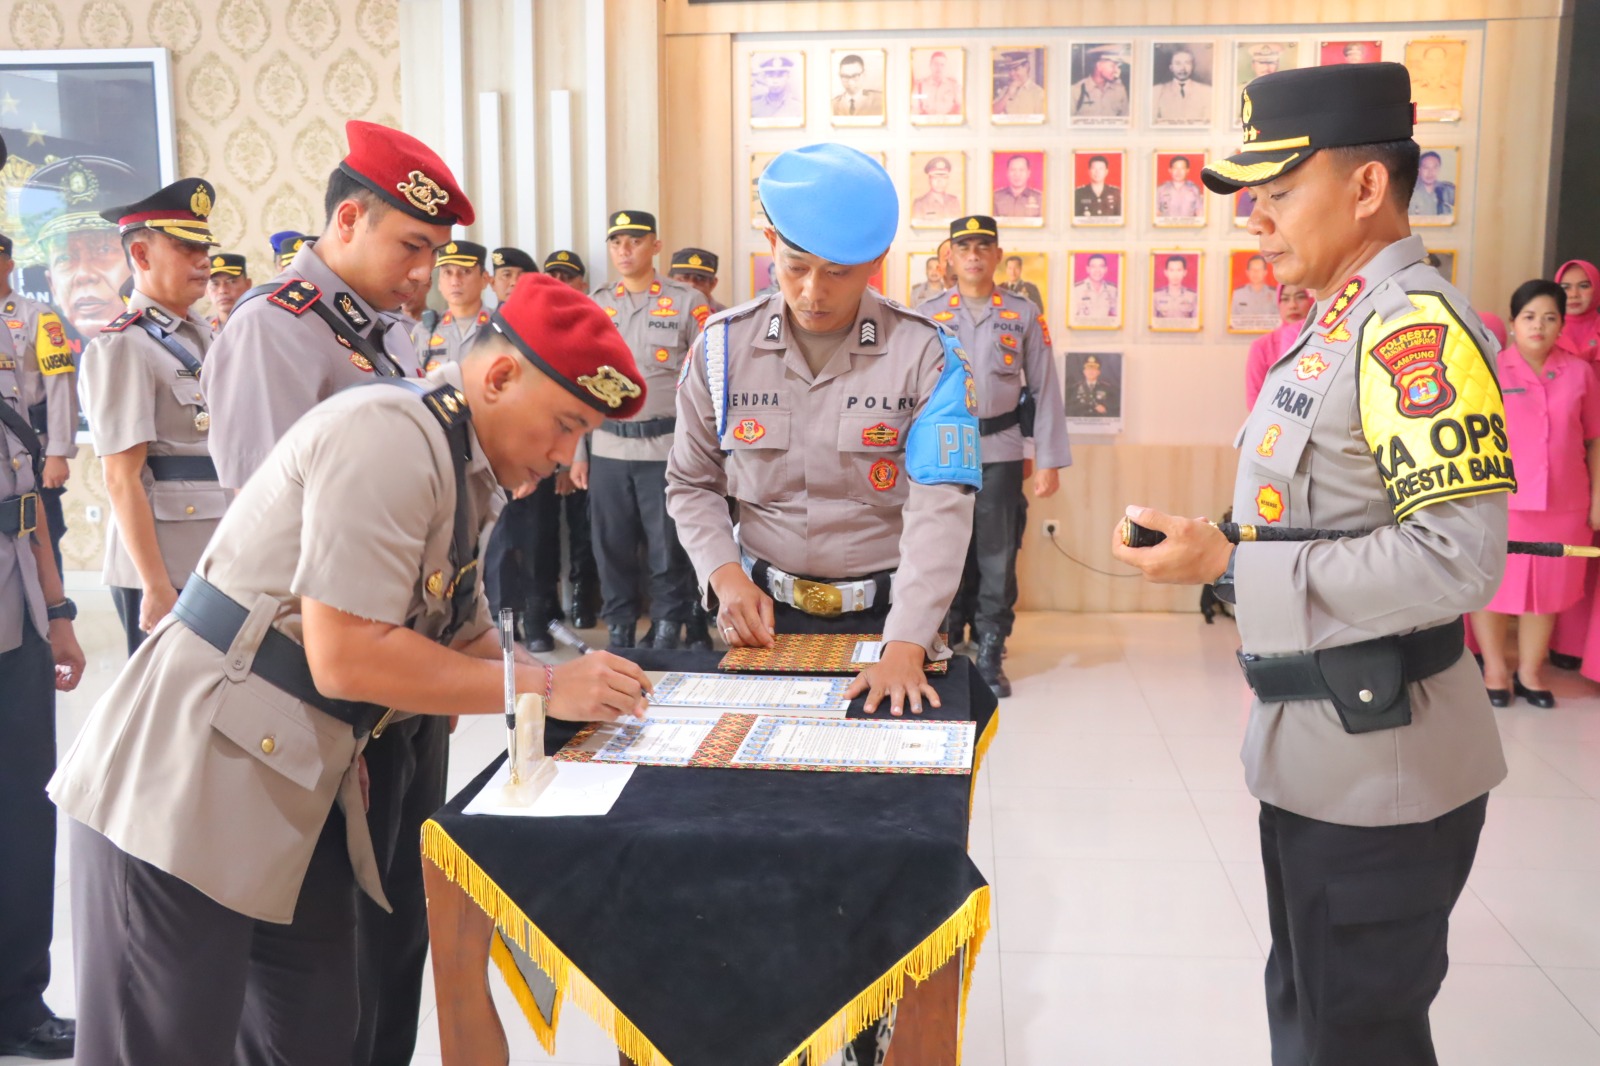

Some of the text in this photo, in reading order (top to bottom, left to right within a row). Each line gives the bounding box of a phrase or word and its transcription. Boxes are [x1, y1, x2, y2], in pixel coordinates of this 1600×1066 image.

[648, 320, 679, 331] POLRI
[993, 322, 1024, 333] POLRI
[1379, 329, 1438, 355] POLRESTA
[1392, 350, 1436, 371] LAMPUNG
[729, 392, 779, 407] ENDRA
[1273, 385, 1313, 419] POLRI
[1430, 412, 1508, 459] OPS
